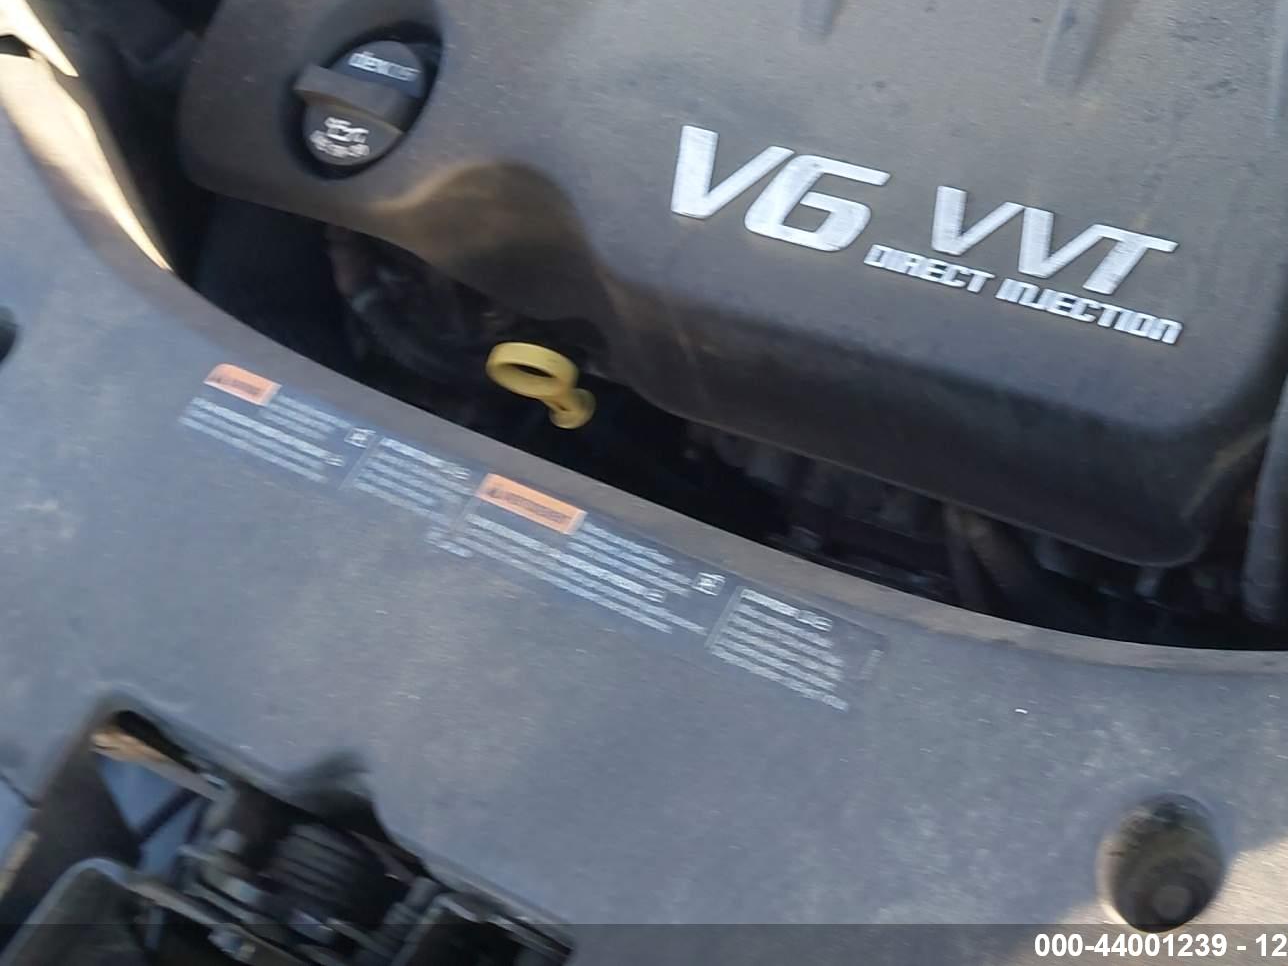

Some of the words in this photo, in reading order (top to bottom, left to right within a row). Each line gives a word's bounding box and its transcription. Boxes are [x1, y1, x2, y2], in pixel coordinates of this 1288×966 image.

[670, 124, 891, 252] V6
[930, 184, 1179, 296] VVT
[863, 244, 995, 294] DIRECT
[994, 277, 1185, 346] INJECTION
